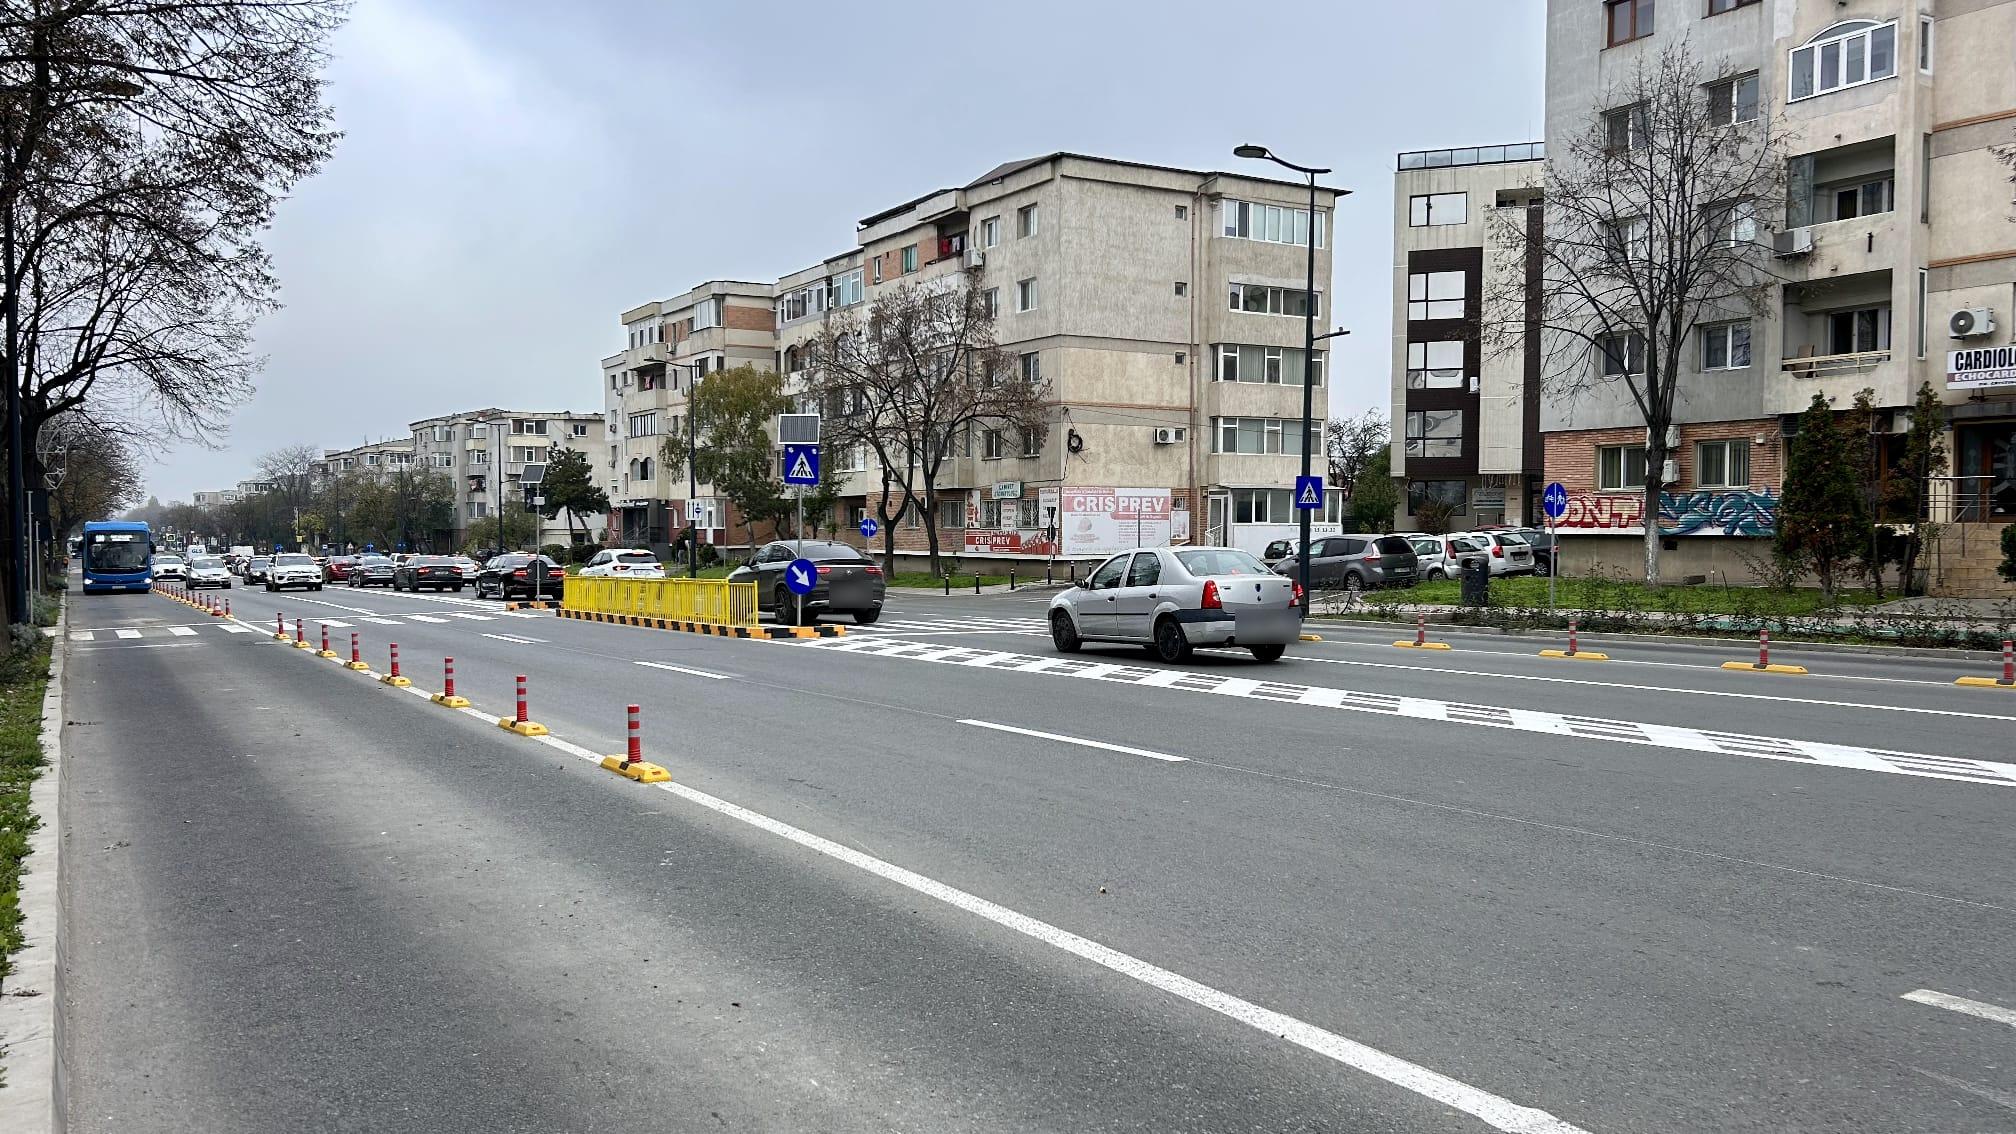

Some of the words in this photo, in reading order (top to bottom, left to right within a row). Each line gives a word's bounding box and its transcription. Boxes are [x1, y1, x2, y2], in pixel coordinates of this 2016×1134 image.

[1955, 347, 2016, 371] CARDIOL
[1073, 496, 1116, 512] CRIS
[1118, 496, 1164, 512] PREV
[975, 536, 991, 545] CRIS
[993, 536, 1011, 545] PREV
